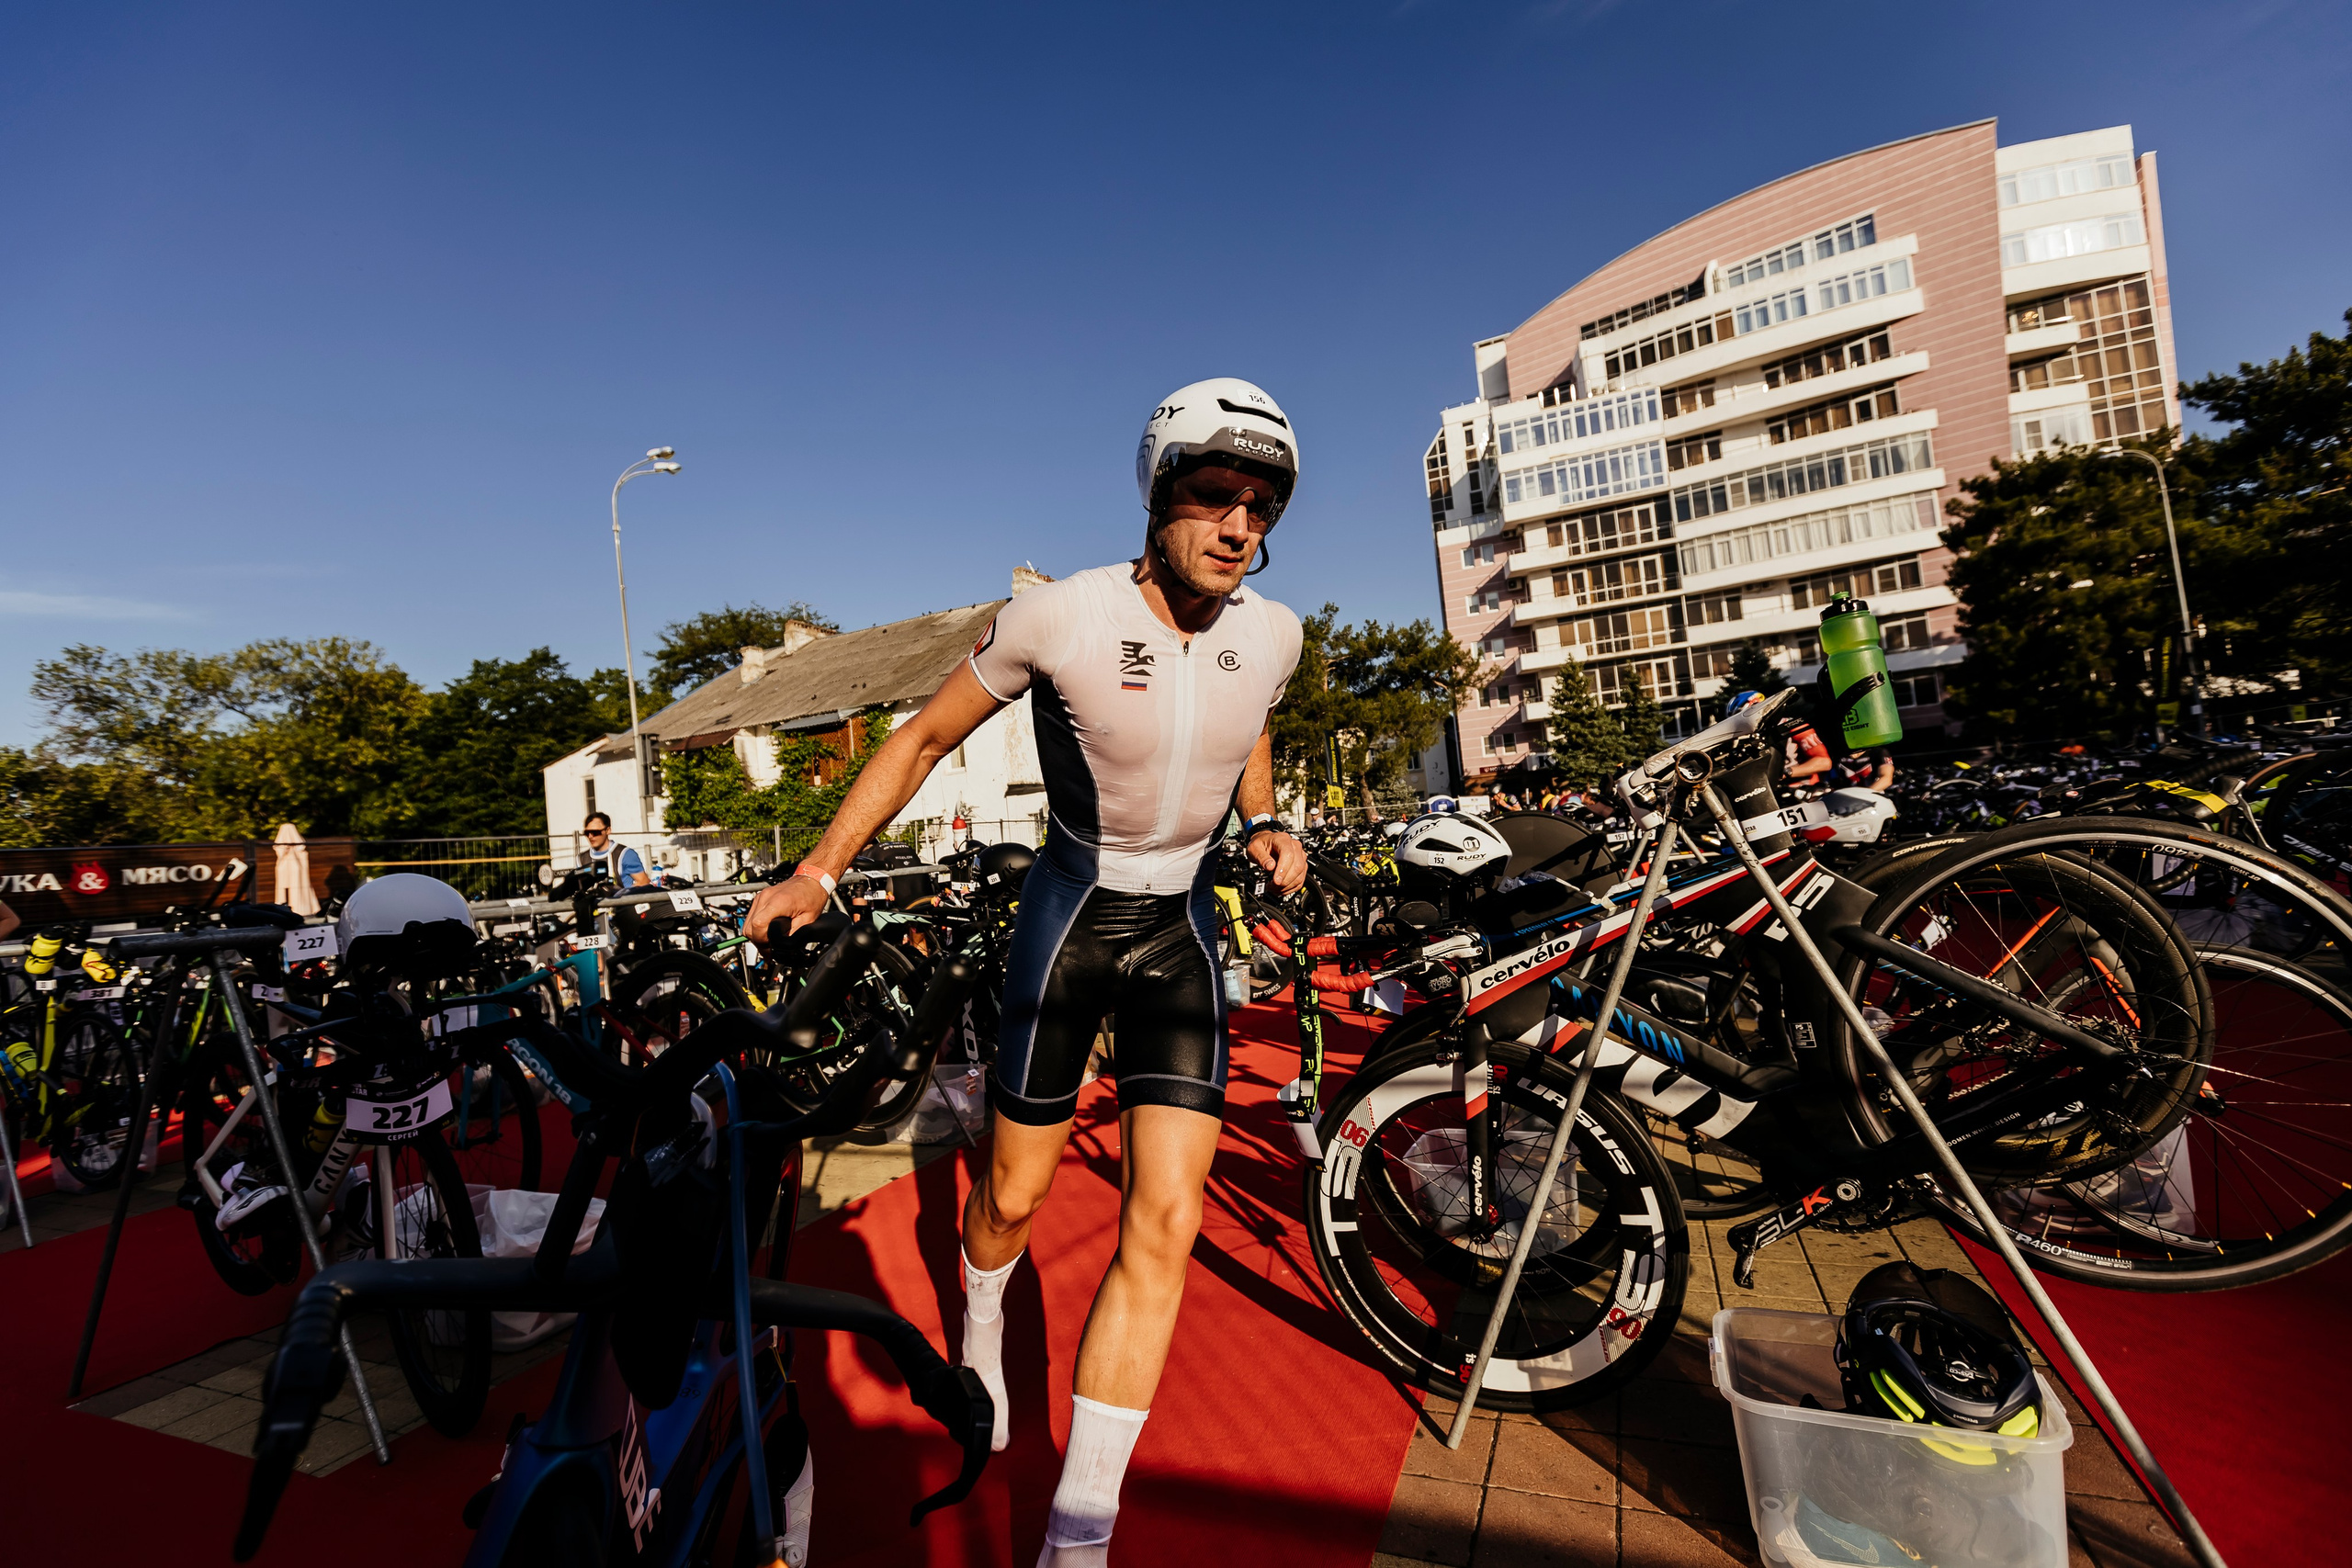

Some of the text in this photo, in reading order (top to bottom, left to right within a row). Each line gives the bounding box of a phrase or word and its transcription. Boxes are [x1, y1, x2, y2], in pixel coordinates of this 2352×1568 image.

[1248, 394, 1266, 405] 156
[1150, 405, 1185, 422] DY
[1233, 437, 1284, 458] RUDY
[1850, 723, 1870, 731] EIGHT
[1777, 807, 1808, 828] 151
[1402, 819, 1442, 849] RUDY
[1892, 837, 1967, 858] CONTINENTAL
[1433, 856, 1445, 864] 152
[77, 871, 107, 891] &
[121, 863, 212, 886] МЯСО
[1375, 922, 1396, 936] 3T
[297, 937, 324, 951] 227
[584, 938, 599, 947] 228
[1480, 940, 1571, 989] cervélo
[1263, 983, 1282, 997] SWISS
[504, 1037, 572, 1105] RGON 18
[372, 1096, 429, 1130] 227
[387, 1129, 420, 1142] СЕРГЕЙ
[1516, 1077, 1636, 1176] URSUS
[313, 1129, 350, 1195] CANY
[1475, 1155, 1483, 1216] cervélo
[2015, 1232, 2063, 1257] R460
[680, 1387, 701, 1400] 89
